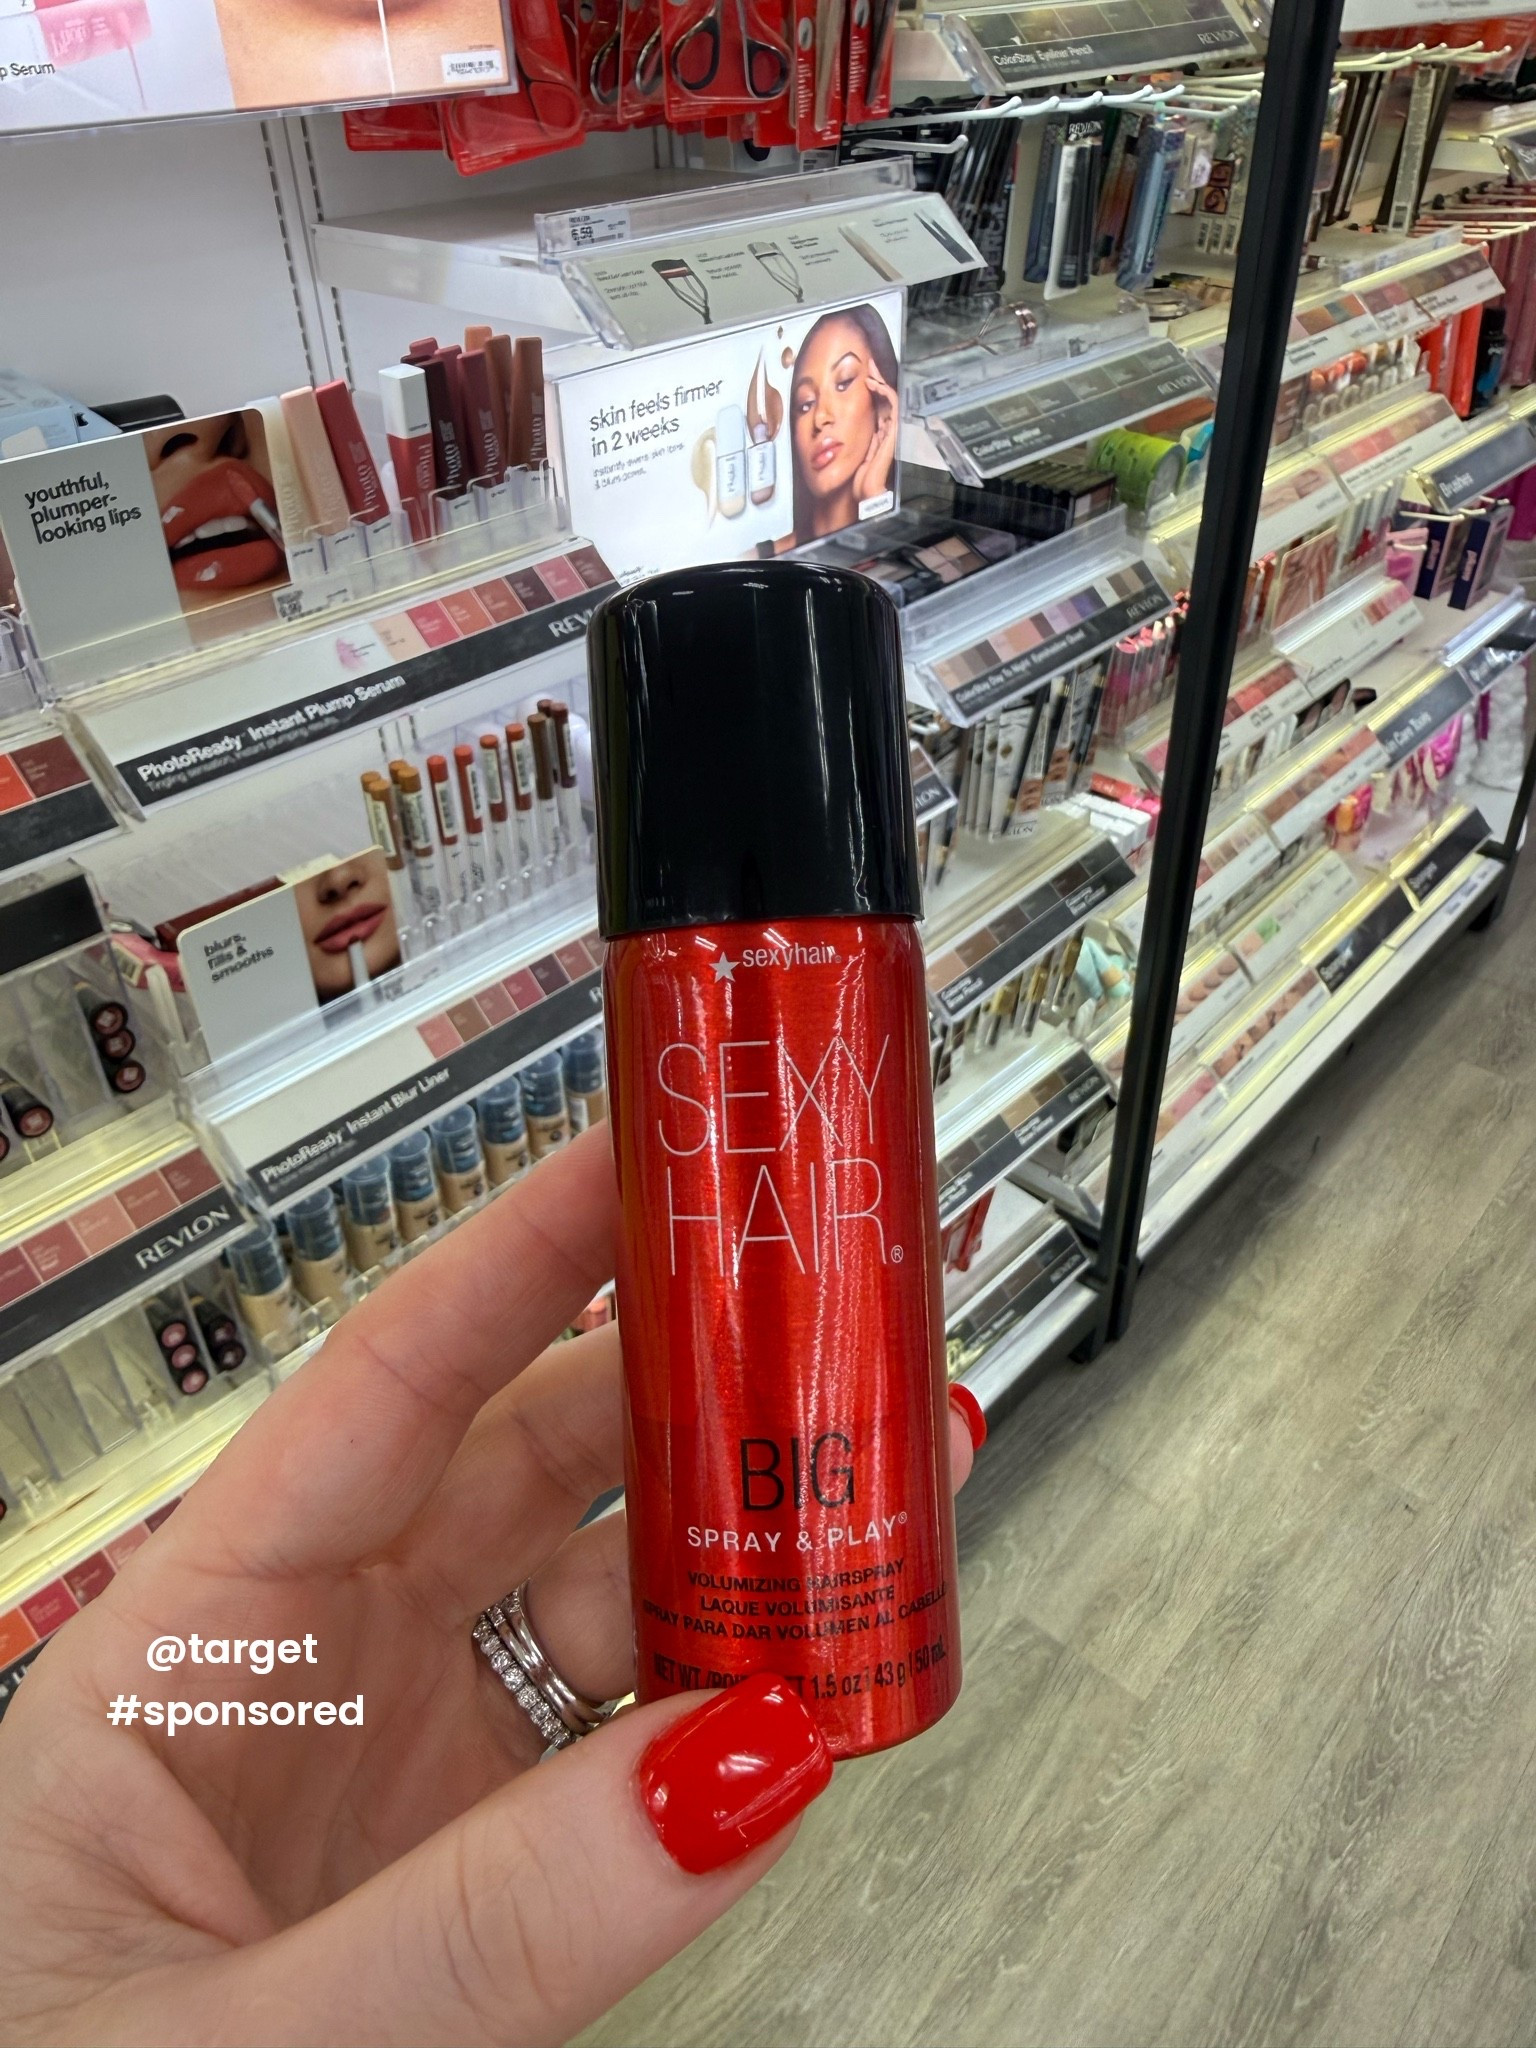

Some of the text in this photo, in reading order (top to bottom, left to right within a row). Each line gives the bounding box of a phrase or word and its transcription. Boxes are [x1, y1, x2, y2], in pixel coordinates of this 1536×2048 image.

[1067, 44, 1095, 59] Pencil
[1198, 28, 1240, 46] REVLON
[10, 63, 56, 77] Serum
[590, 380, 723, 431] skin feels firmer
[591, 417, 679, 457] in 2 weeks
[25, 472, 109, 509] youthful,
[31, 493, 117, 528] plumper-
[36, 505, 142, 544] looking lips
[548, 608, 593, 638] REV
[137, 675, 406, 781] PhotoReady Instant Plump Serum
[204, 933, 246, 957] blurs,
[212, 946, 274, 983] smooths
[657, 1034, 890, 1157] SEXY
[260, 1129, 343, 1182] PhotoReady
[346, 1102, 394, 1134] Instant
[391, 1086, 418, 1108] Blur
[418, 1067, 450, 1093] Liner
[134, 1204, 231, 1270] REVLON
[739, 1432, 855, 1512] BIG
[687, 1525, 782, 1553] SPRAY
[796, 1530, 812, 1553] &
[687, 1558, 905, 1594] VOLUMIZING HAIRSPRAY
[683, 1615, 728, 1639] PARA
[732, 1623, 772, 1641] DAR
[777, 1616, 870, 1641] VOLUMEN
[875, 1609, 895, 1628] AL
[898, 1580, 946, 1619] CABELL
[700, 1584, 896, 1617] LAQUE VOLUMISANTE
[812, 1672, 838, 1699] 1.5
[841, 1674, 862, 1696] oz
[875, 1660, 894, 1688] 43
[896, 1662, 905, 1688] g
[915, 1644, 930, 1673] 50
